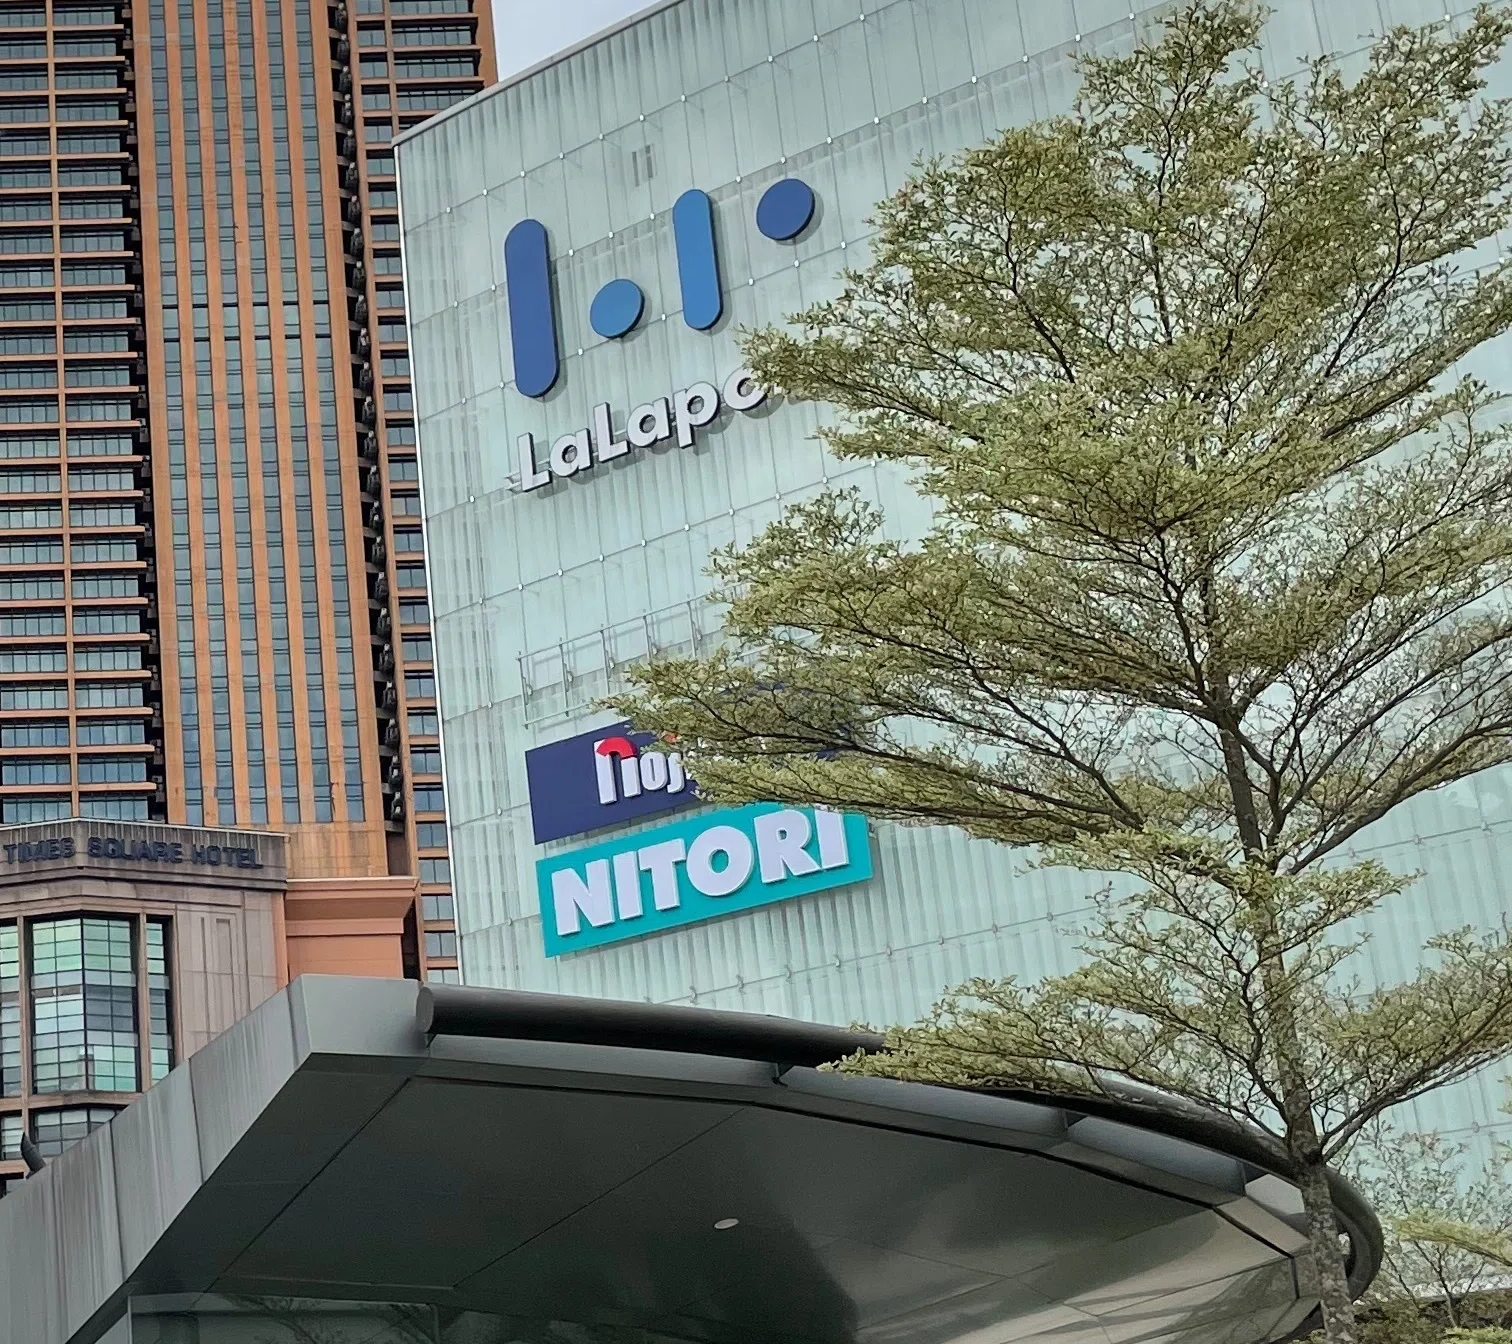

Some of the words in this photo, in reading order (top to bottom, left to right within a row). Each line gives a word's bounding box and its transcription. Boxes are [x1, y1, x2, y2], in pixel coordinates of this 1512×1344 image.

[516, 365, 776, 492] LaLapo
[3, 836, 77, 865] TIMES
[88, 836, 183, 864] SQUARE
[192, 843, 264, 870] HOTEL
[551, 803, 850, 937] NITORI
